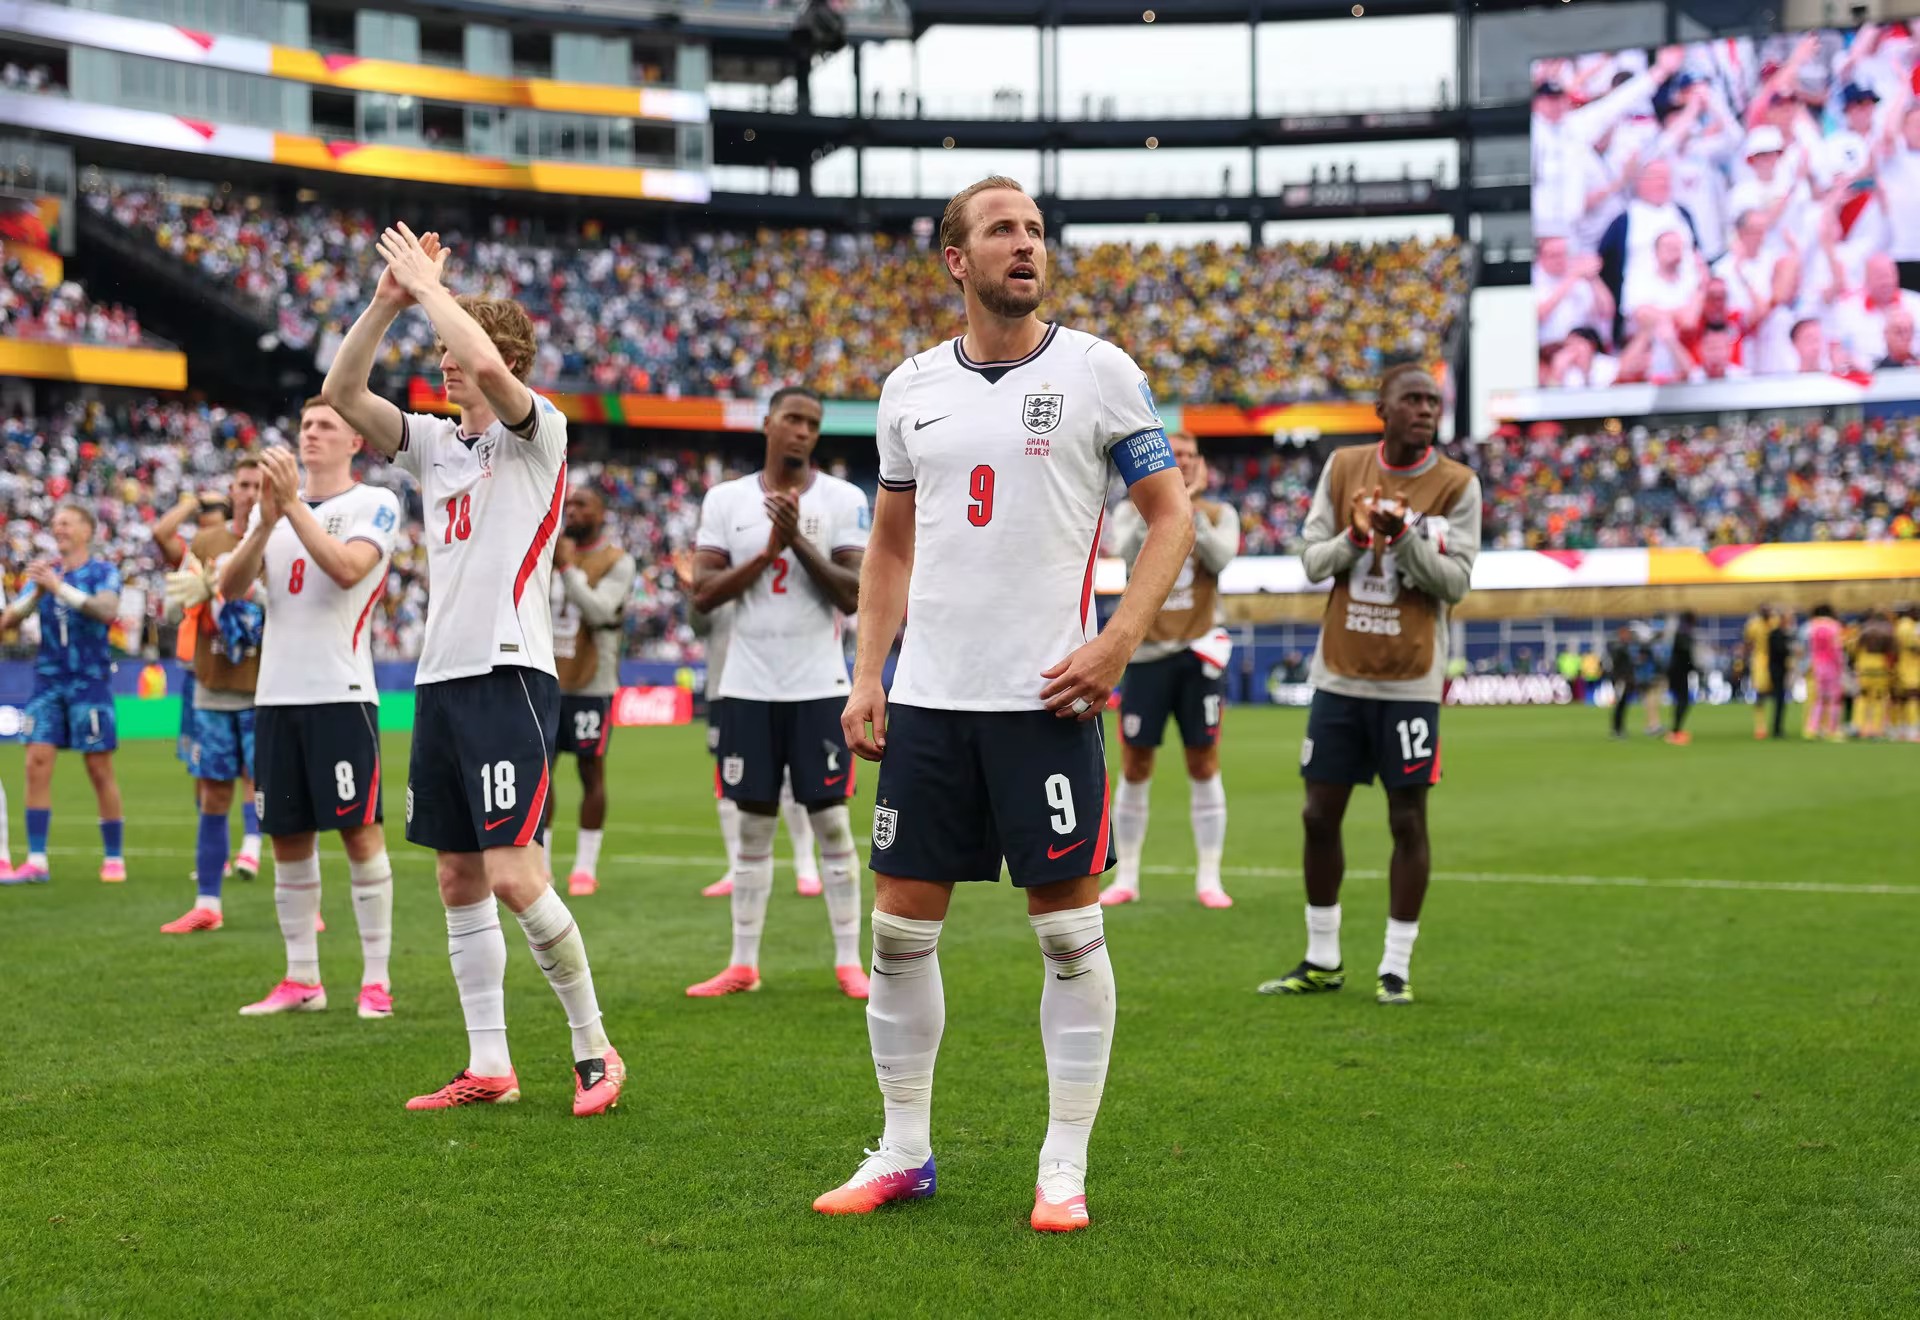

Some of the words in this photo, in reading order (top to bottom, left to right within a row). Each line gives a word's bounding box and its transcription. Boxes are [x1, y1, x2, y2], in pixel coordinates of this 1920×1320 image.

[1024, 447, 1050, 457] 23.06.26
[1026, 438, 1050, 447] GHANA
[1127, 431, 1162, 448] FOOTBALL
[1130, 438, 1166, 459] UNITES
[1133, 458, 1149, 469] the
[1148, 448, 1171, 462] World
[1149, 460, 1165, 471] FIFA
[968, 465, 995, 527] 9
[444, 493, 472, 545] 18
[288, 558, 306, 595] 8
[772, 557, 789, 594] 2
[1345, 614, 1402, 636] 2026
[1449, 674, 1573, 706] AIRWAYS
[574, 710, 601, 740] 22
[1396, 717, 1433, 760] 12
[334, 760, 356, 801] 8
[480, 760, 517, 813] 18
[1044, 773, 1077, 835] 9
